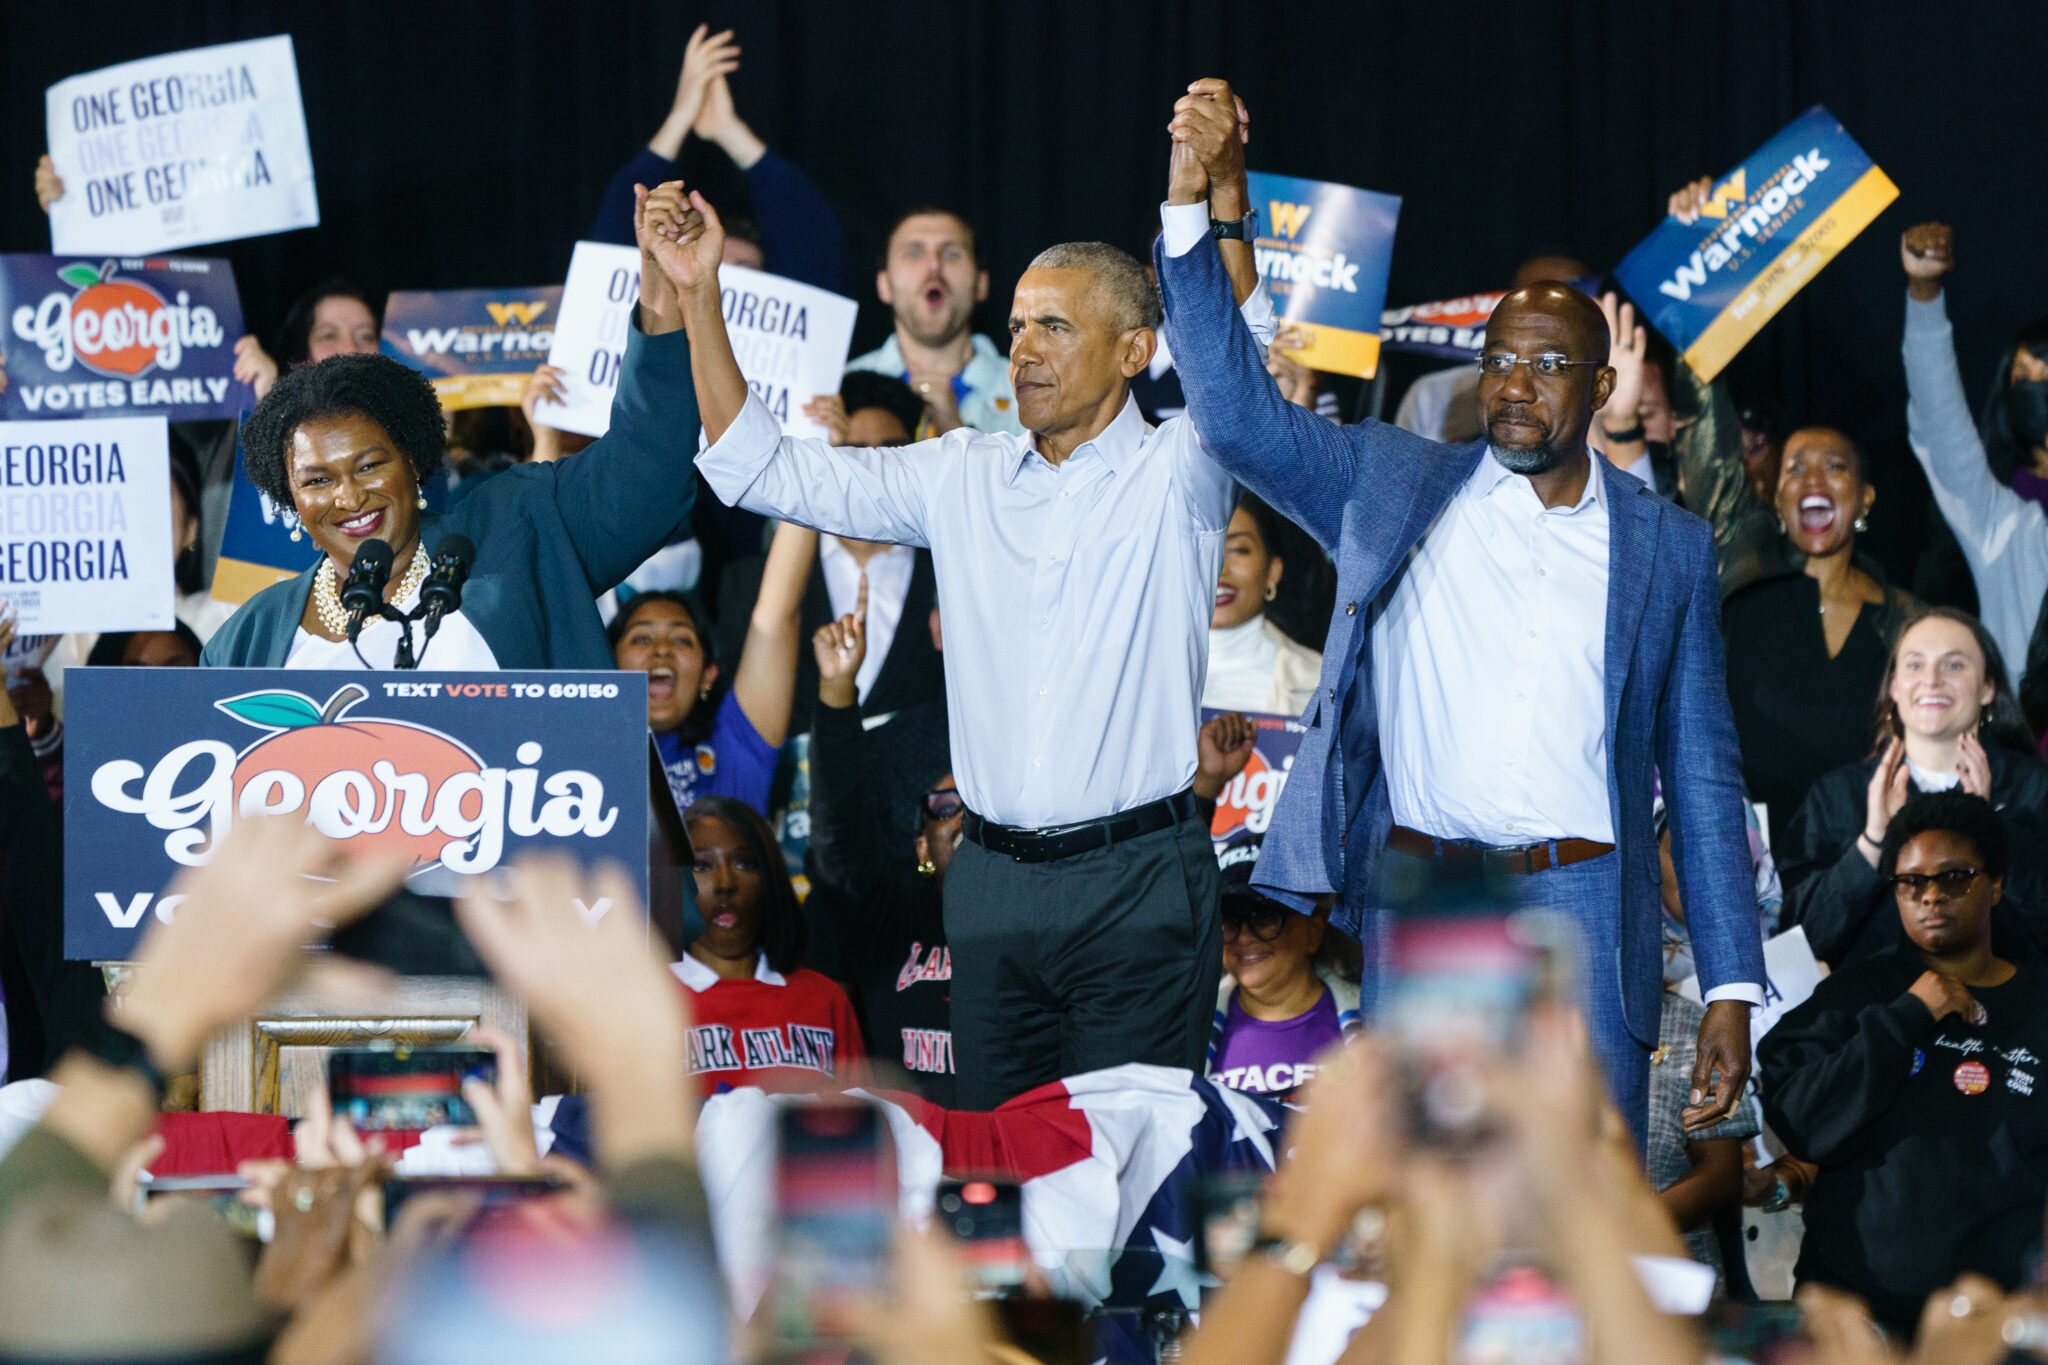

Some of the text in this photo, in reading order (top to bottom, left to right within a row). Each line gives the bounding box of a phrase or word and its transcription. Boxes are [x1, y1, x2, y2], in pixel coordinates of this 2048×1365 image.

[72, 64, 258, 133] ONE GEORGIA
[78, 111, 266, 174] ONE GEOA
[86, 172, 141, 217] ONE
[1658, 147, 1831, 302] Warnock
[1255, 248, 1361, 294] rnock
[12, 290, 225, 372] Georgia
[719, 287, 808, 342] ORGIA
[406, 327, 555, 356] Warno
[19, 377, 229, 411] VOTES EARLY
[0, 443, 126, 487] EORGIA
[0, 491, 127, 536] EORGIA
[0, 539, 129, 583] EORGIA
[382, 683, 619, 699] TEXT VOTE TO 60150
[91, 739, 619, 875] Georgia
[685, 1023, 835, 1078] ARK ATLANT
[901, 1027, 955, 1074] UNI
[1212, 1063, 1325, 1092] TACE
